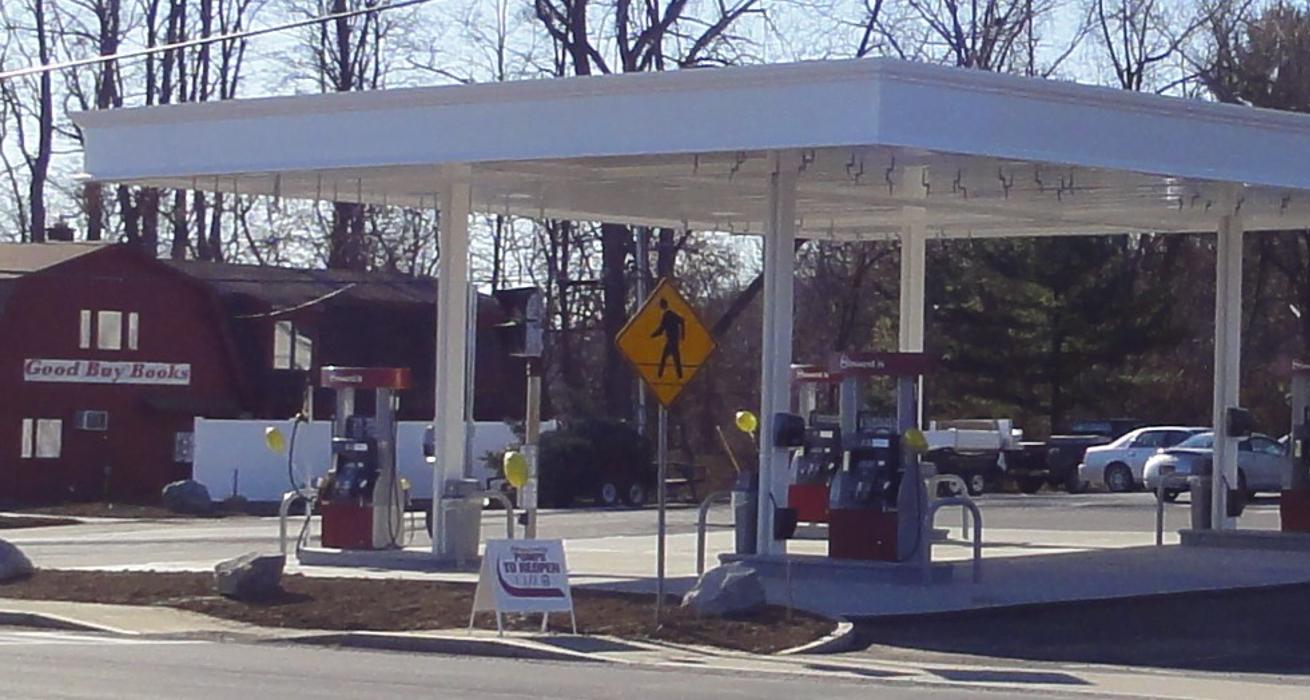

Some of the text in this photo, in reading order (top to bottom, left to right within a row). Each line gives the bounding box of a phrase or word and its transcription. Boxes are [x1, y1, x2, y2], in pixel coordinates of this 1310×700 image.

[25, 359, 189, 382] Good Buy Books
[503, 562, 561, 574] TO REOPEN
